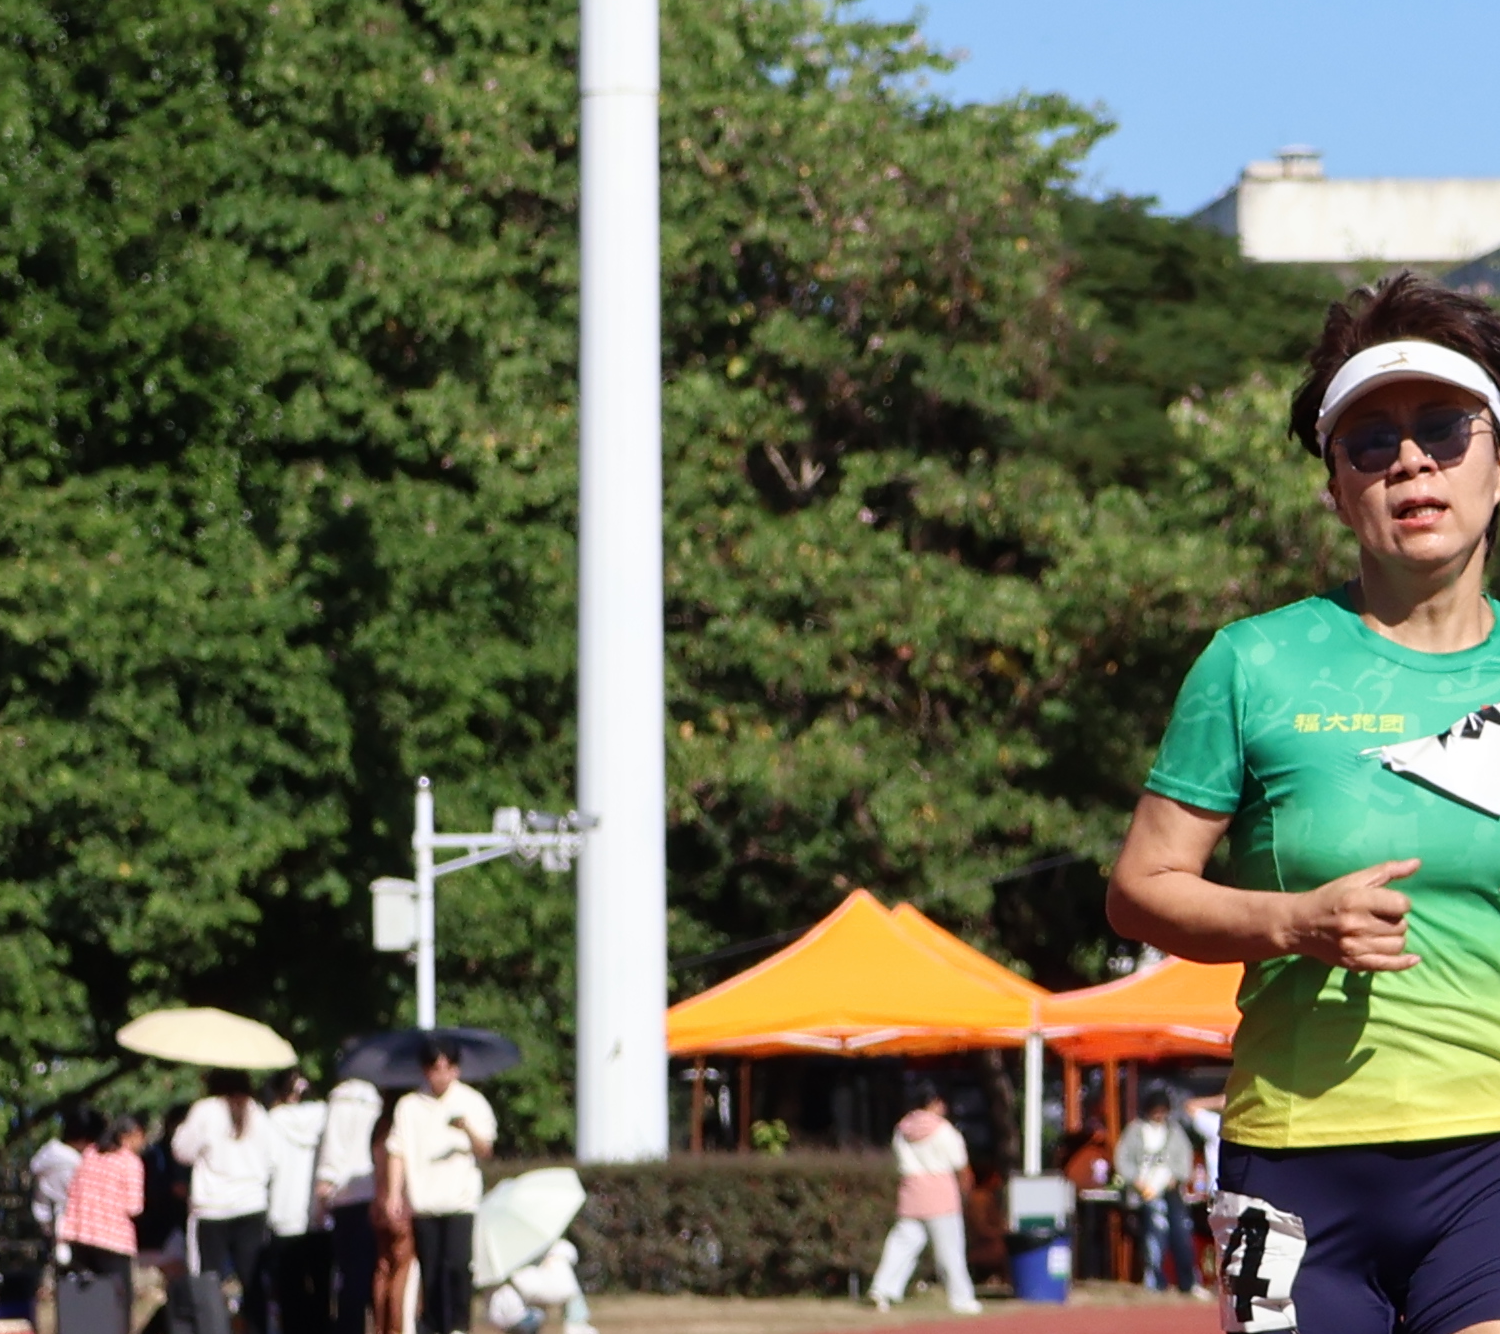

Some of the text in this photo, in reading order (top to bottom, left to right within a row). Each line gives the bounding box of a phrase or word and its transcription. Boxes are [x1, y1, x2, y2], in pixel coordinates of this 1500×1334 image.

[1293, 712, 1406, 734] 福大跑团
[1219, 1206, 1271, 1324] 4
